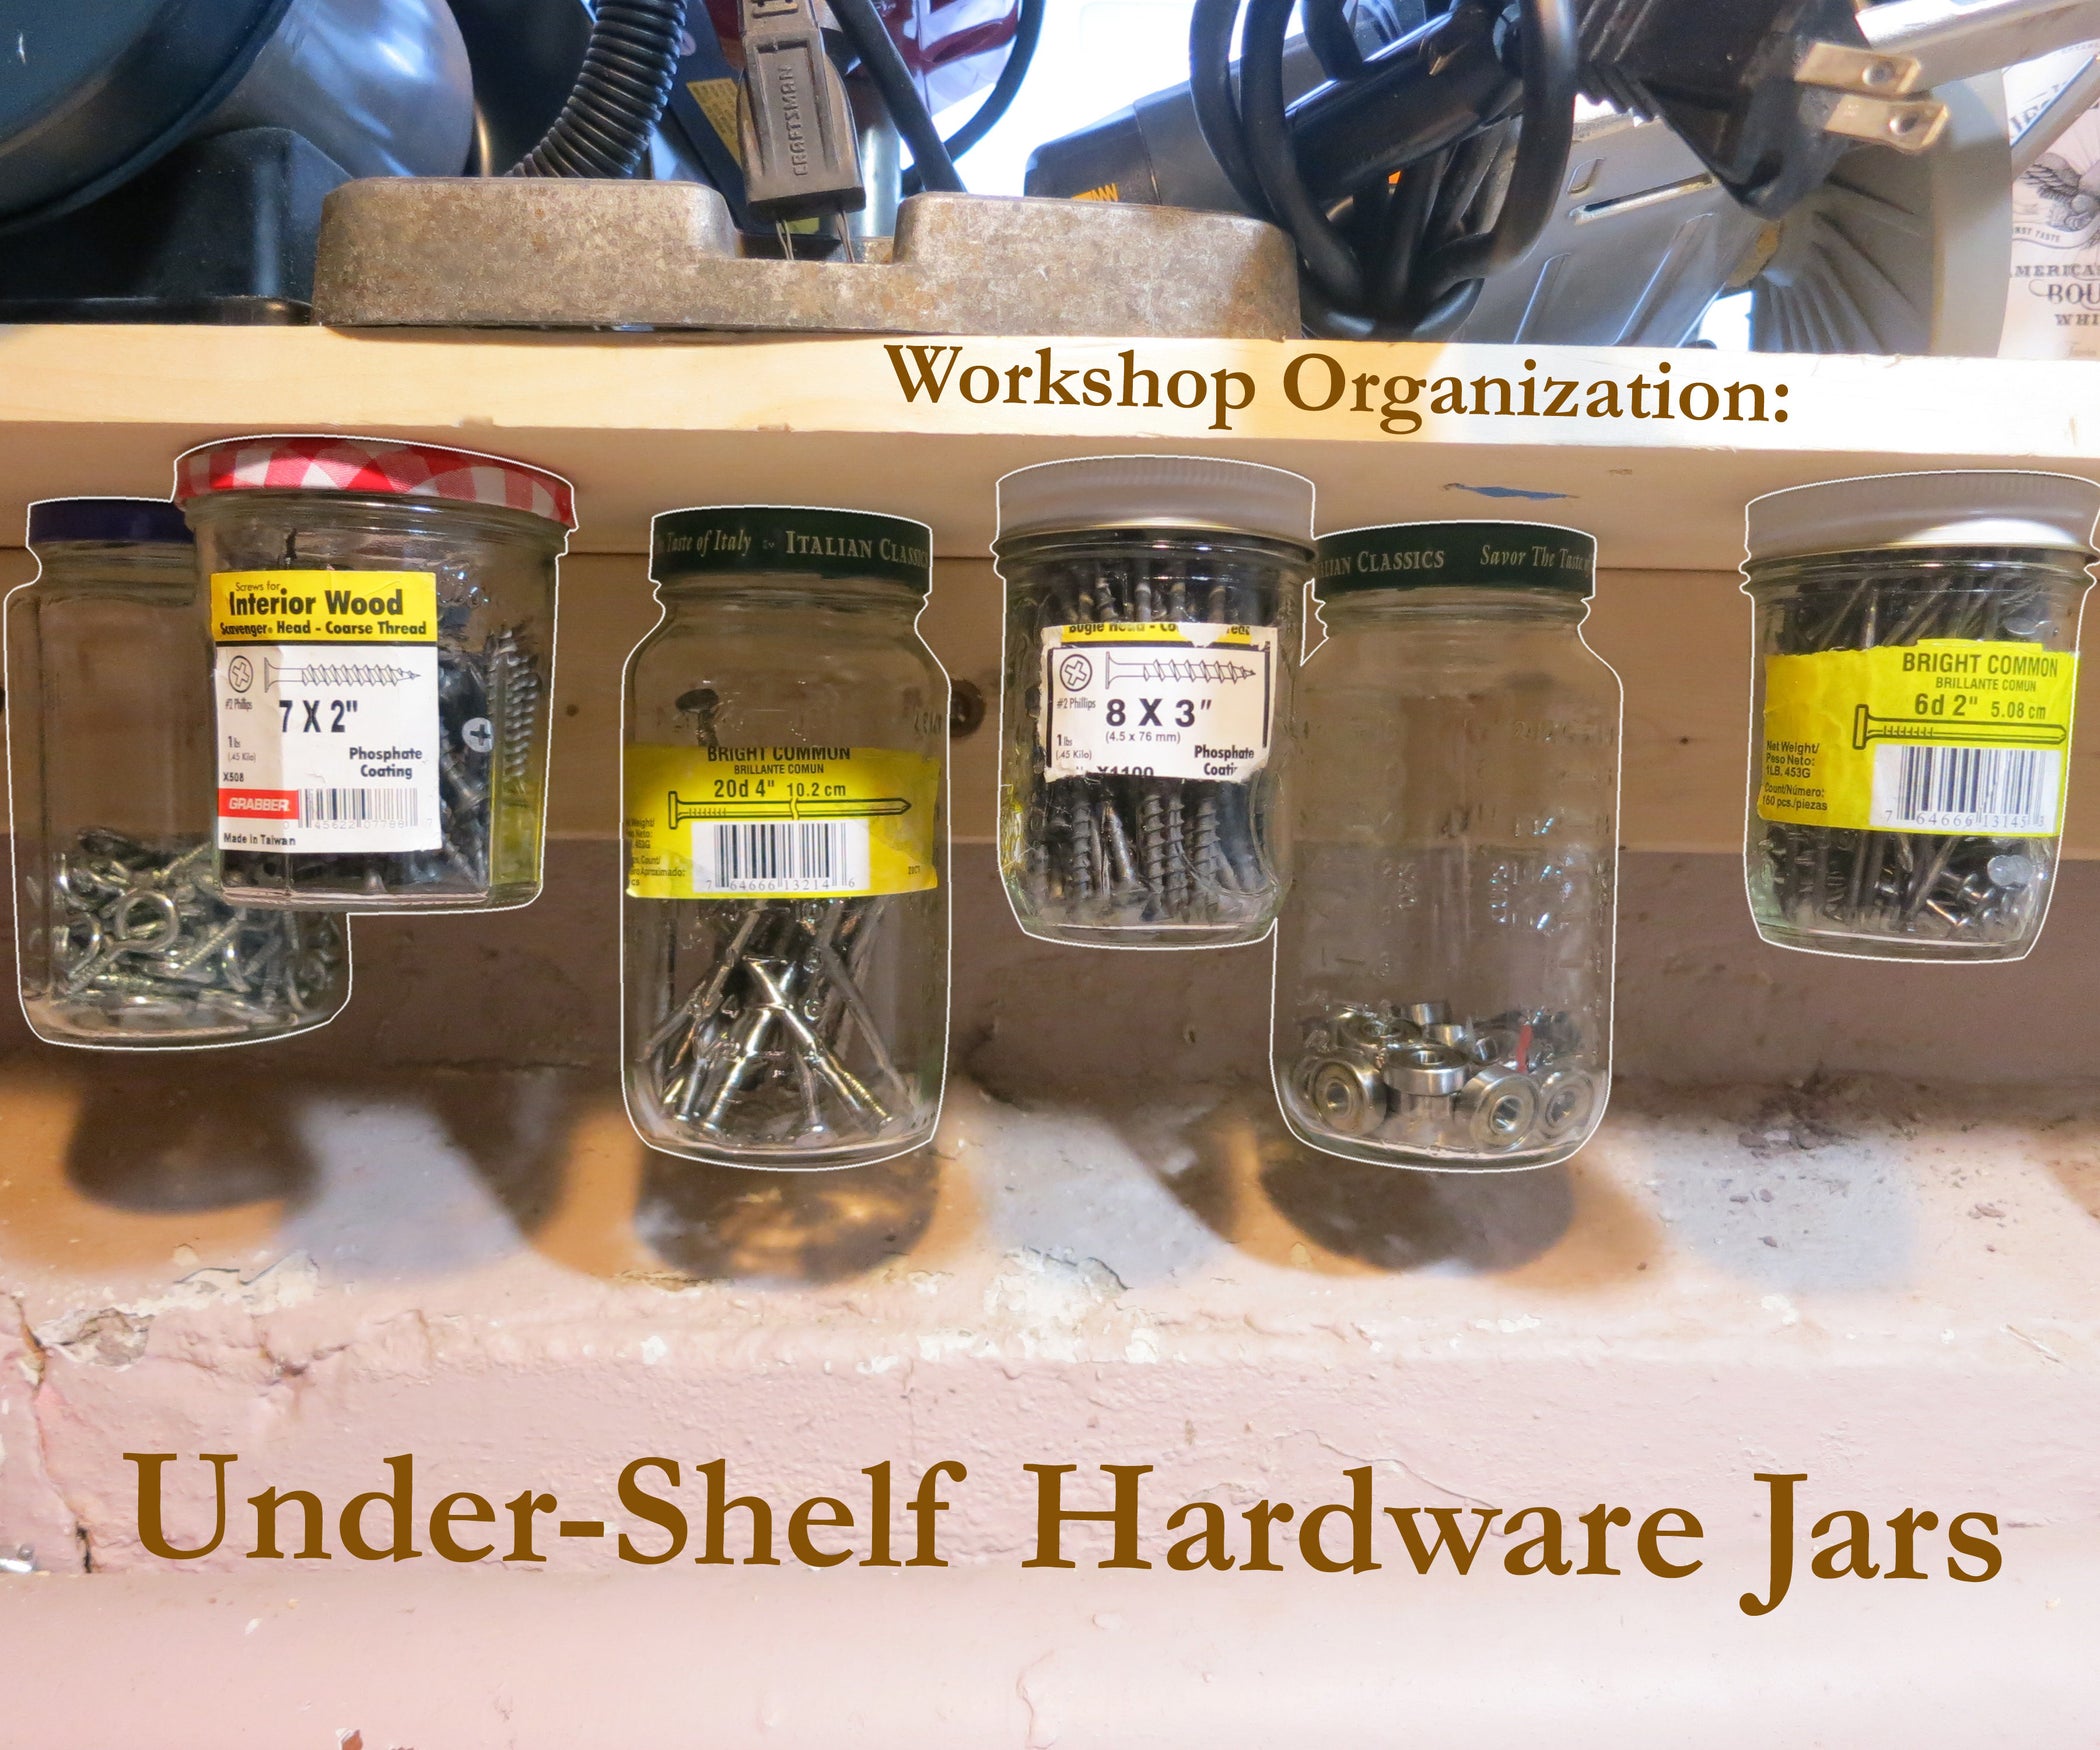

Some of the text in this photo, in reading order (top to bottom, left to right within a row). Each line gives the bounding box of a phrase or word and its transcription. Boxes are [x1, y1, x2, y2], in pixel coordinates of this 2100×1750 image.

[777, 64, 809, 177] CRAFTSMAN
[2010, 264, 2100, 278] MERICA
[2047, 283, 2100, 305] BOU
[2054, 313, 2100, 326] WHI
[696, 529, 712, 558] of
[713, 528, 752, 557] Italy
[785, 530, 873, 560] ITALIAN
[1357, 549, 1445, 573] CLASSICS
[1480, 544, 1527, 567] Savor
[1531, 545, 1556, 567] The
[235, 581, 280, 592] Screws for
[229, 587, 404, 616] Interior Wood
[276, 620, 311, 634] Head
[326, 621, 373, 635] Coarse
[377, 621, 427, 635] Thread
[1902, 652, 2059, 678] BRIGHT COMMON
[1935, 676, 2037, 692] BRILLANTE COMUN
[1056, 697, 1096, 711] #2 Phillips
[1914, 692, 2047, 720] 6d 2" 5.08 cm
[278, 699, 359, 733] 7 X 2"
[1105, 698, 1213, 728] 8 X 3"
[1056, 734, 1062, 746] 1
[1105, 731, 1181, 744] (4.5 x 76 mm)
[1766, 740, 1780, 751] Net
[349, 745, 423, 763] Phosphate
[707, 746, 767, 761] BRIGHT
[1073, 749, 1092, 761] Kilo)
[1194, 744, 1255, 762] Phosphate
[1766, 752, 1816, 766] Peso Neto:
[222, 771, 245, 783] X508
[360, 763, 413, 780] Coating
[734, 763, 825, 775] BRILLANTE COMUN
[1784, 766, 1811, 779] 453G
[714, 778, 847, 798] 20d 4" 10.2 cm
[228, 796, 290, 812] GRABBER
[314, 819, 357, 830] 45622
[1885, 810, 1893, 822] 7
[1916, 812, 1974, 829] 64666
[1983, 815, 2027, 829] 13145
[223, 832, 248, 844] Made
[260, 834, 297, 846] Taiwan
[705, 878, 856, 892] 7 64666 13214 6
